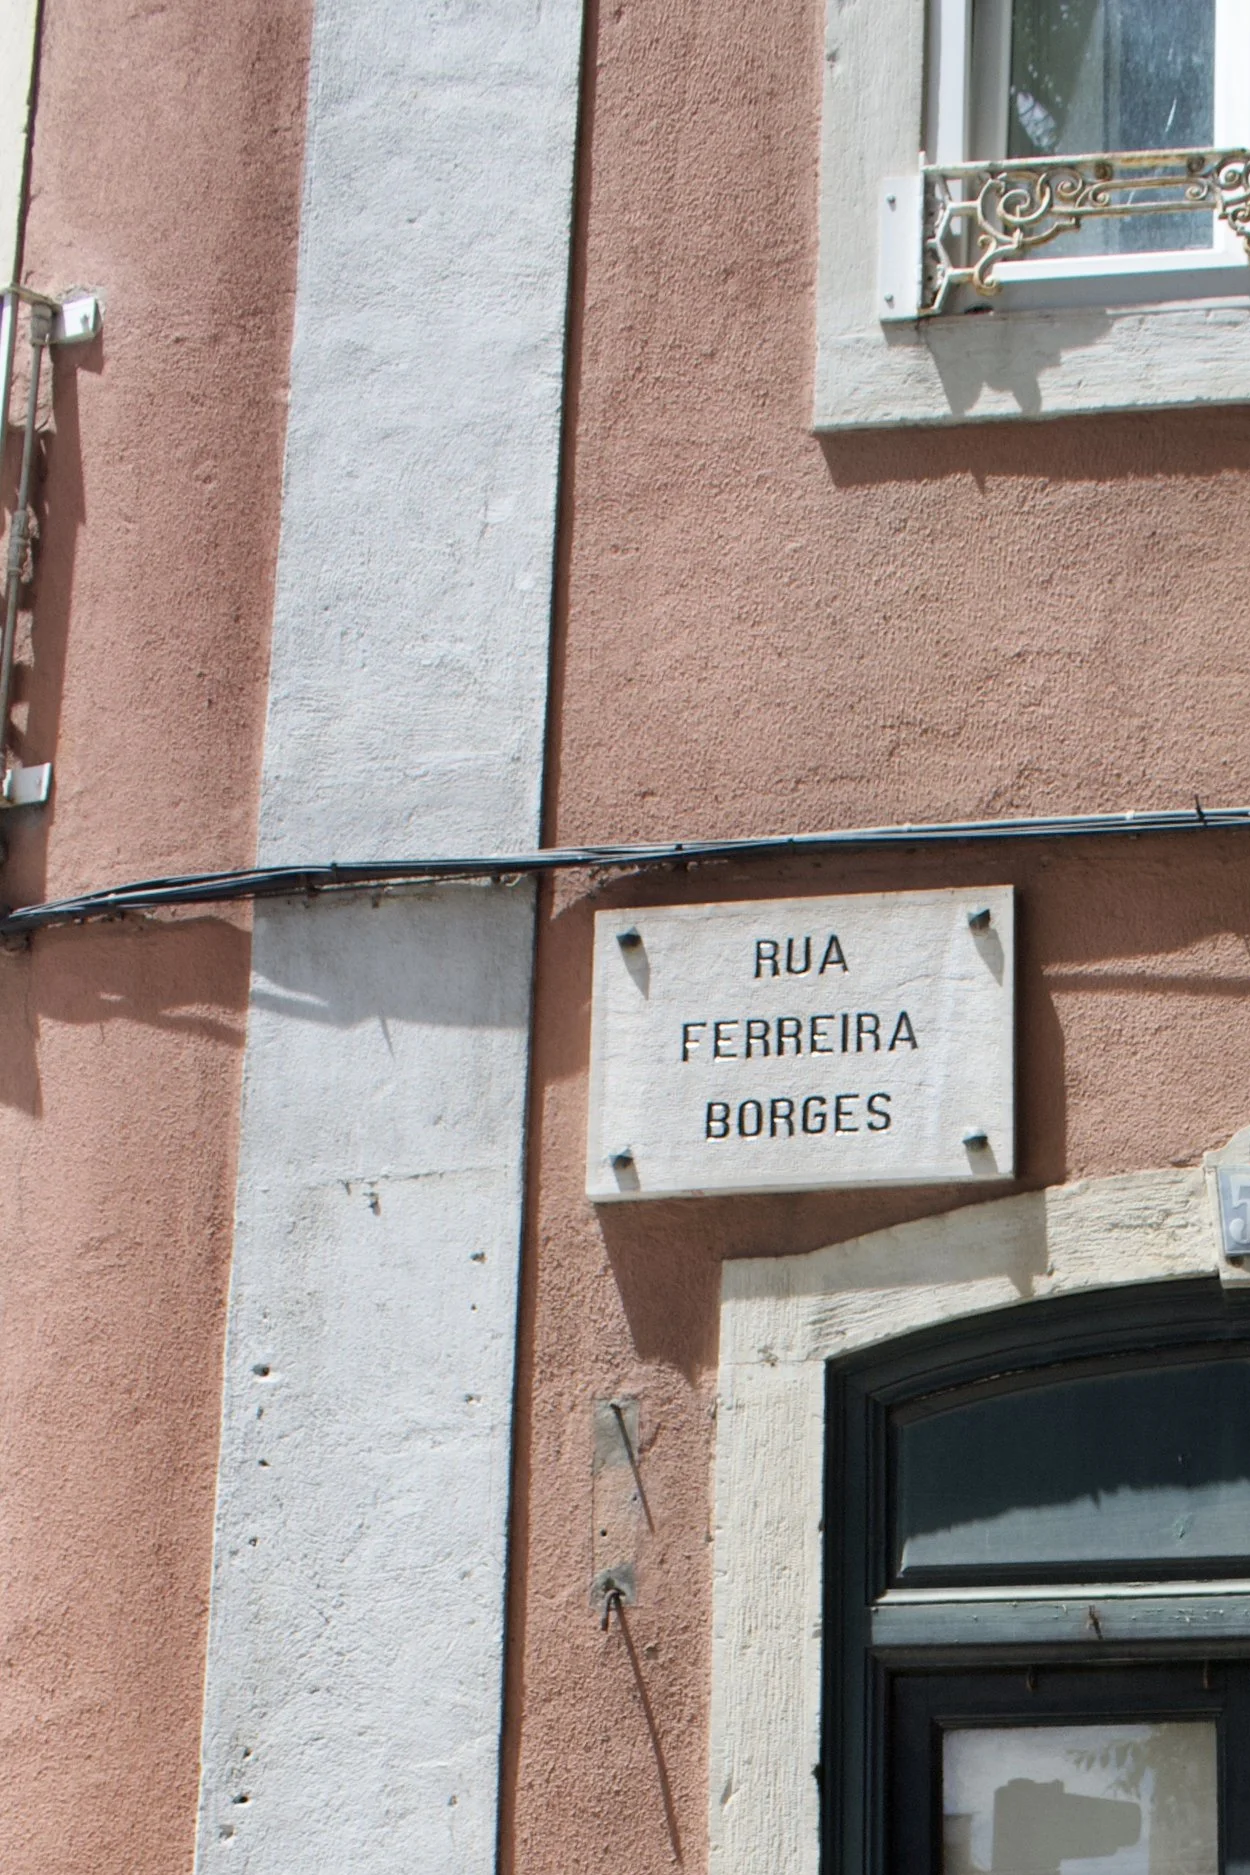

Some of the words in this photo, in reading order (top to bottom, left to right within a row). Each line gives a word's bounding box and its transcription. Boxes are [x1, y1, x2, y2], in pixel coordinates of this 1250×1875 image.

[754, 934, 849, 979] RUA
[681, 1011, 919, 1063] FERREIRA
[704, 1092, 893, 1141] BORGES
